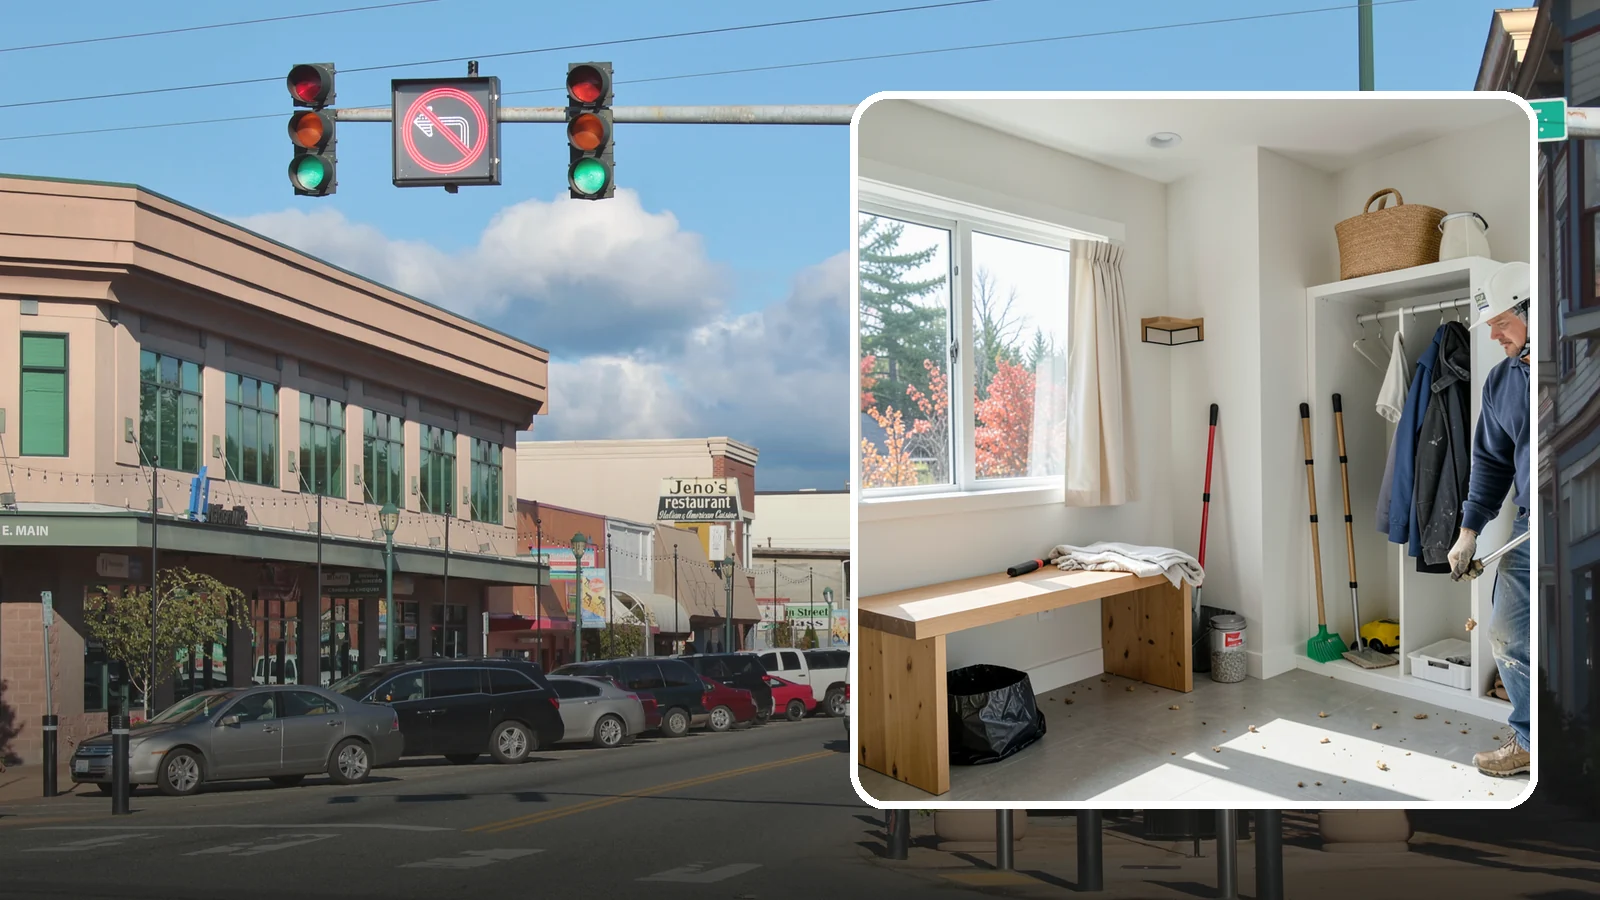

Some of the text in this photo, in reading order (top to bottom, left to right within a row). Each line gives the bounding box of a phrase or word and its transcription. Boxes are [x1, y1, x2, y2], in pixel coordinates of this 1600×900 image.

[670, 480, 728, 495] Jeno's
[665, 496, 731, 509] restaurant
[659, 509, 681, 520] Italian
[685, 509, 715, 519] American
[715, 509, 737, 519] Cuisine
[2, 525, 49, 536] E. MAIN
[798, 608, 828, 616] Street
[791, 619, 824, 627] lass
